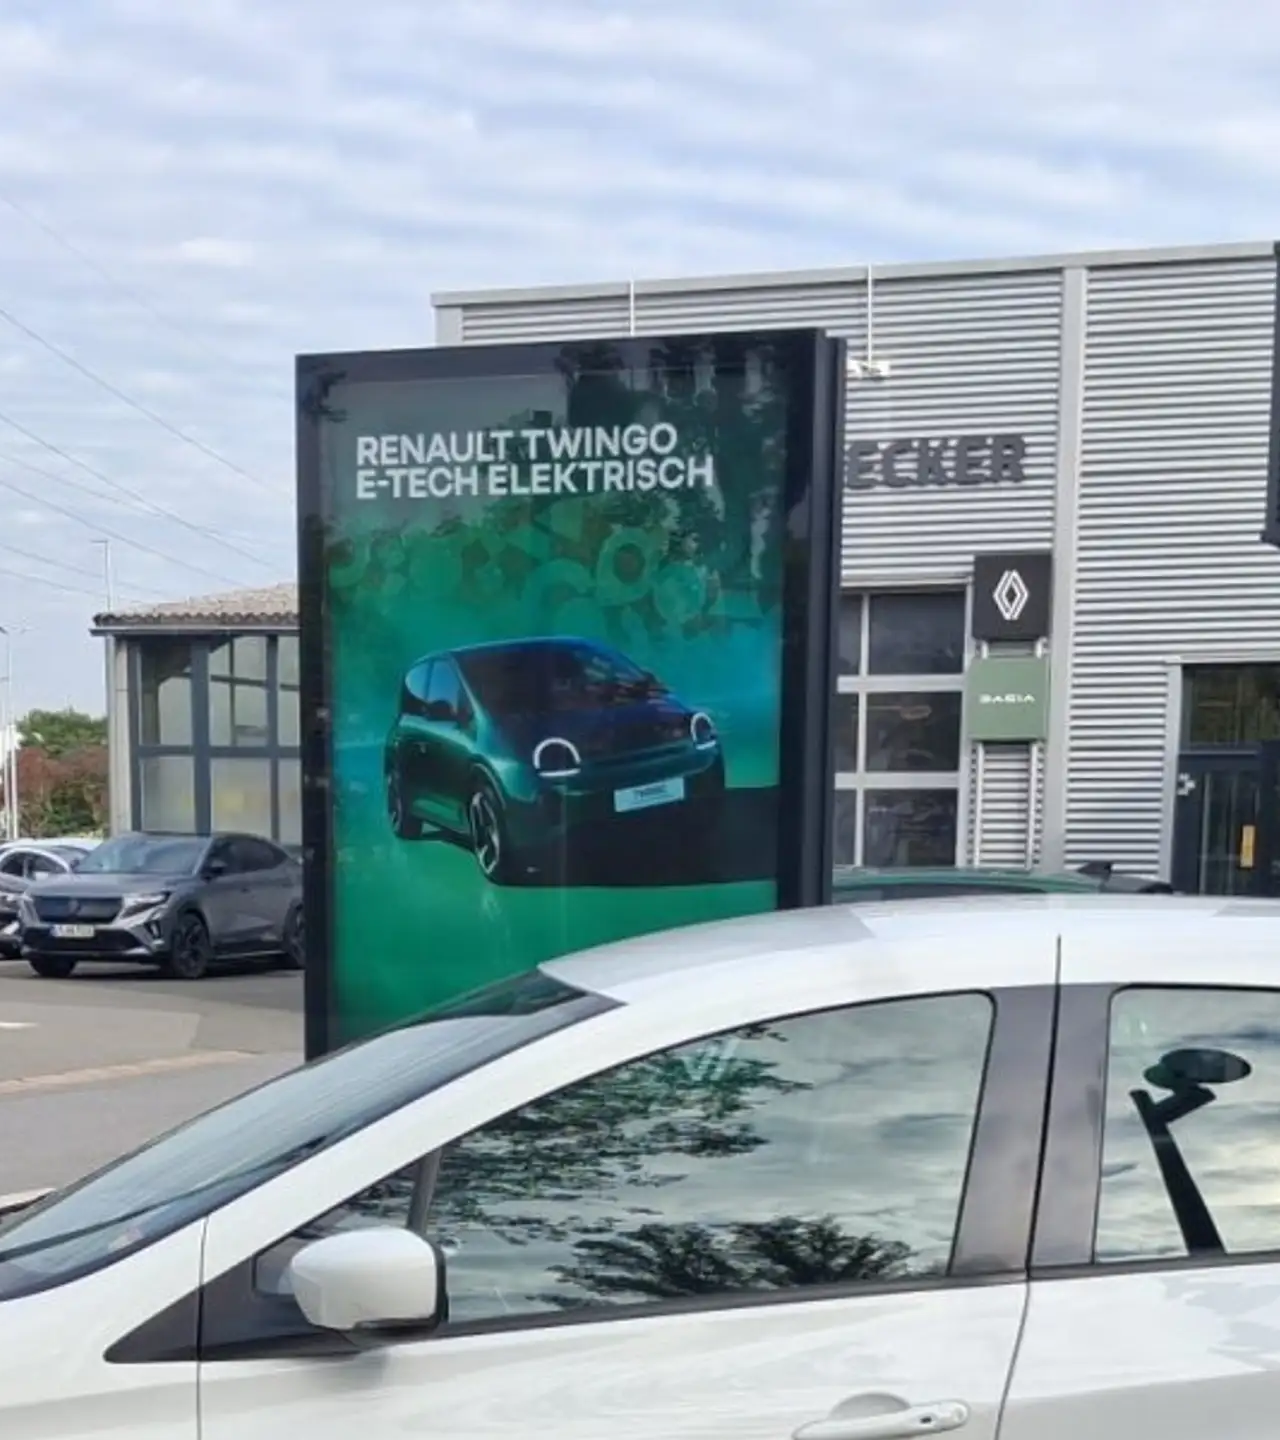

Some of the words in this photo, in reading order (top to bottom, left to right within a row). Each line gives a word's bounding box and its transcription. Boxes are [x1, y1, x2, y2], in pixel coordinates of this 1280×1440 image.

[356, 430, 515, 466] RENAULT
[521, 422, 678, 461] TWINGO
[356, 464, 478, 500] E-TECH
[488, 454, 714, 495] ELEKTRISCH
